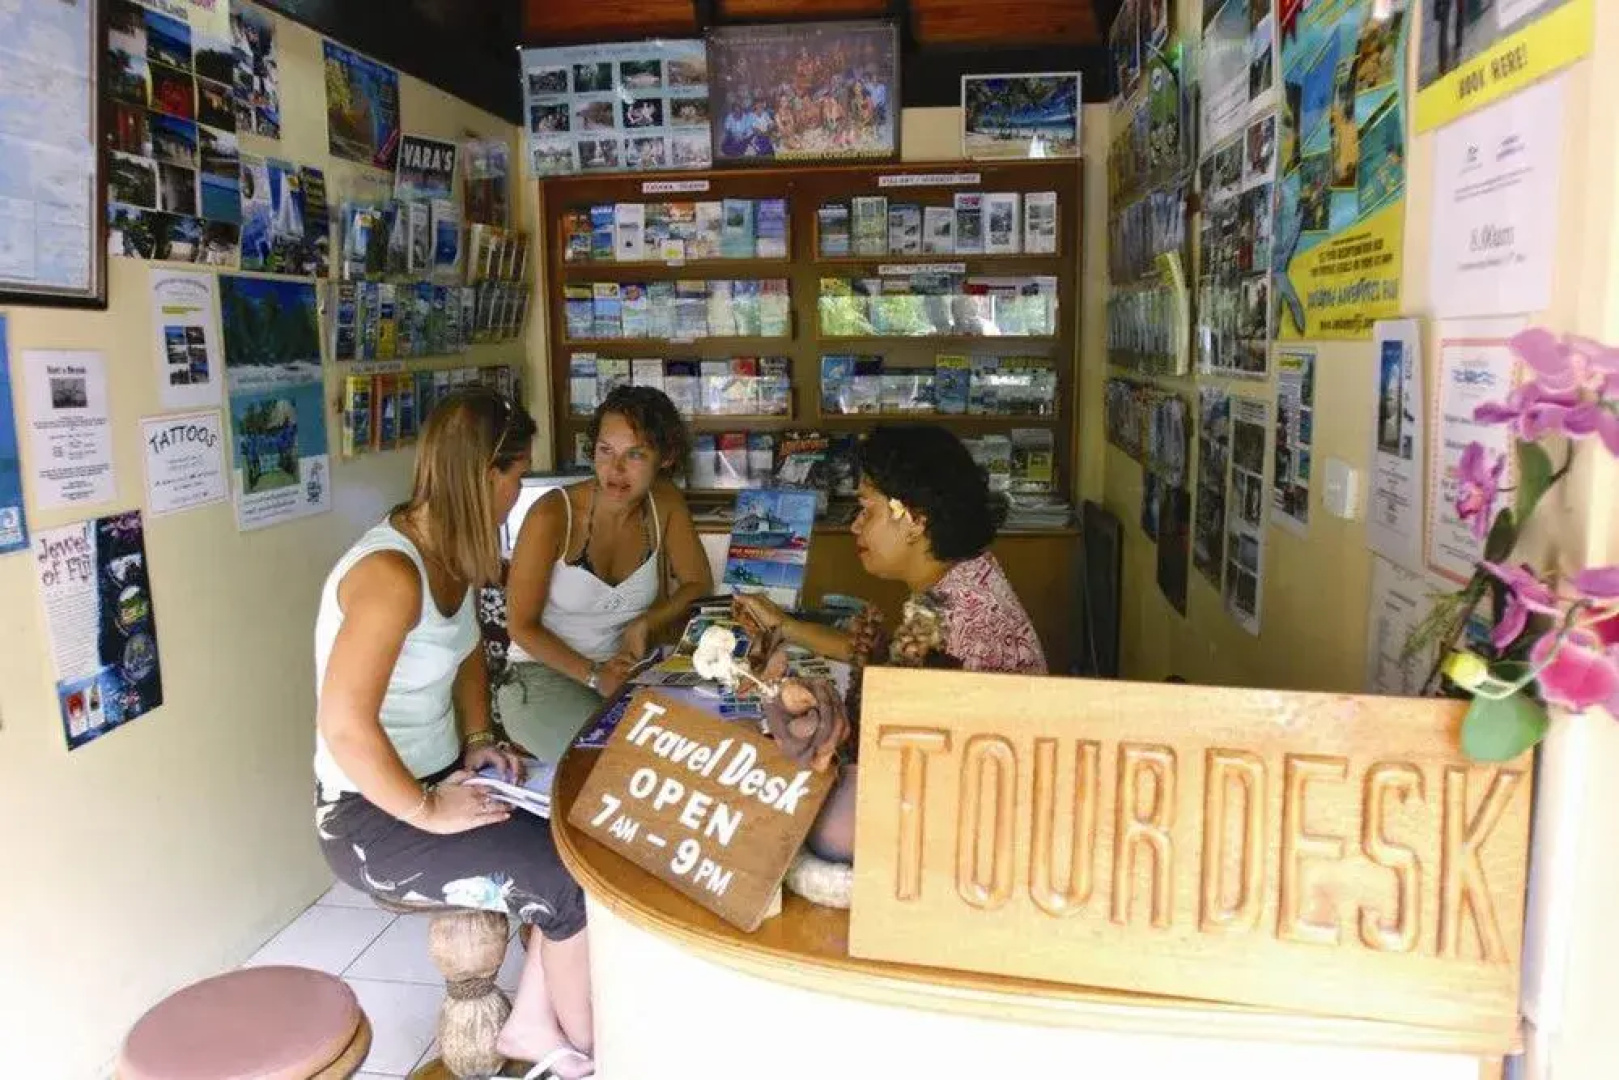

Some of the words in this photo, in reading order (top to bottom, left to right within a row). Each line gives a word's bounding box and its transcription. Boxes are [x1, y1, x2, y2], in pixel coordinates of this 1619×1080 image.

[404, 142, 453, 171] VARA'S
[149, 424, 217, 454] TATTOOS
[626, 702, 734, 777] Travel
[717, 742, 812, 815] Desk
[628, 768, 743, 846] OPEN
[876, 723, 1177, 928] TOUR
[1197, 747, 1528, 964] DESK
